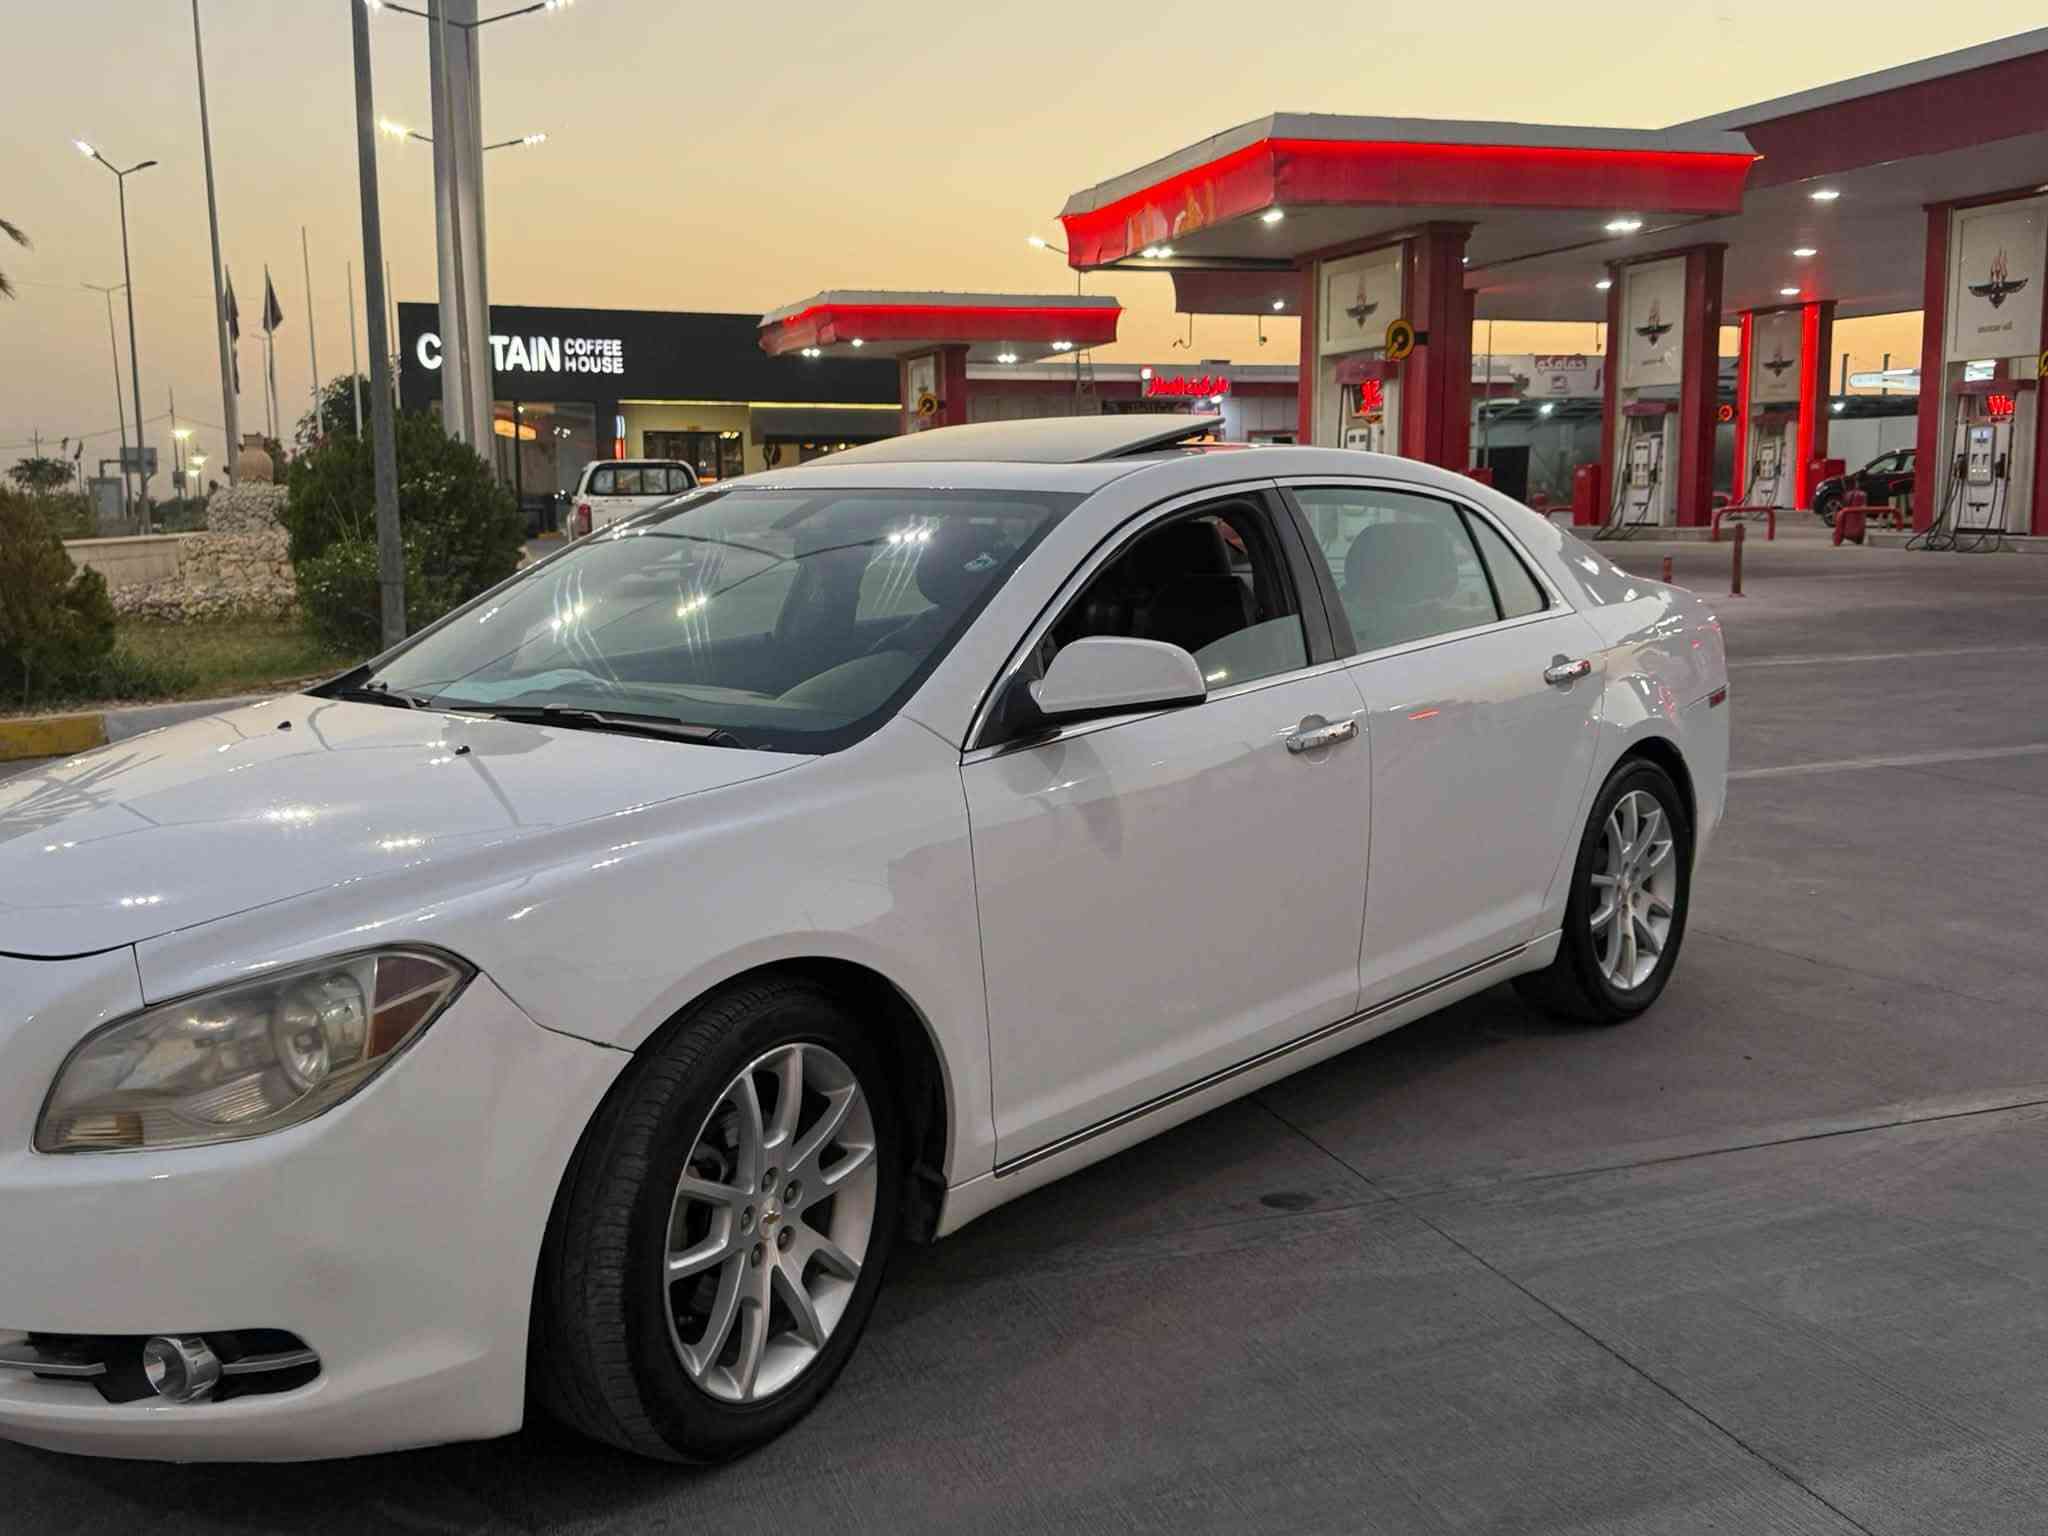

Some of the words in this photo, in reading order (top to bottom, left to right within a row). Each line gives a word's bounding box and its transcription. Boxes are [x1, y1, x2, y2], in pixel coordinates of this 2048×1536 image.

[416, 332, 560, 372] CTAIN
[564, 338, 623, 357] COFFEE
[564, 356, 625, 374] HOUSE
